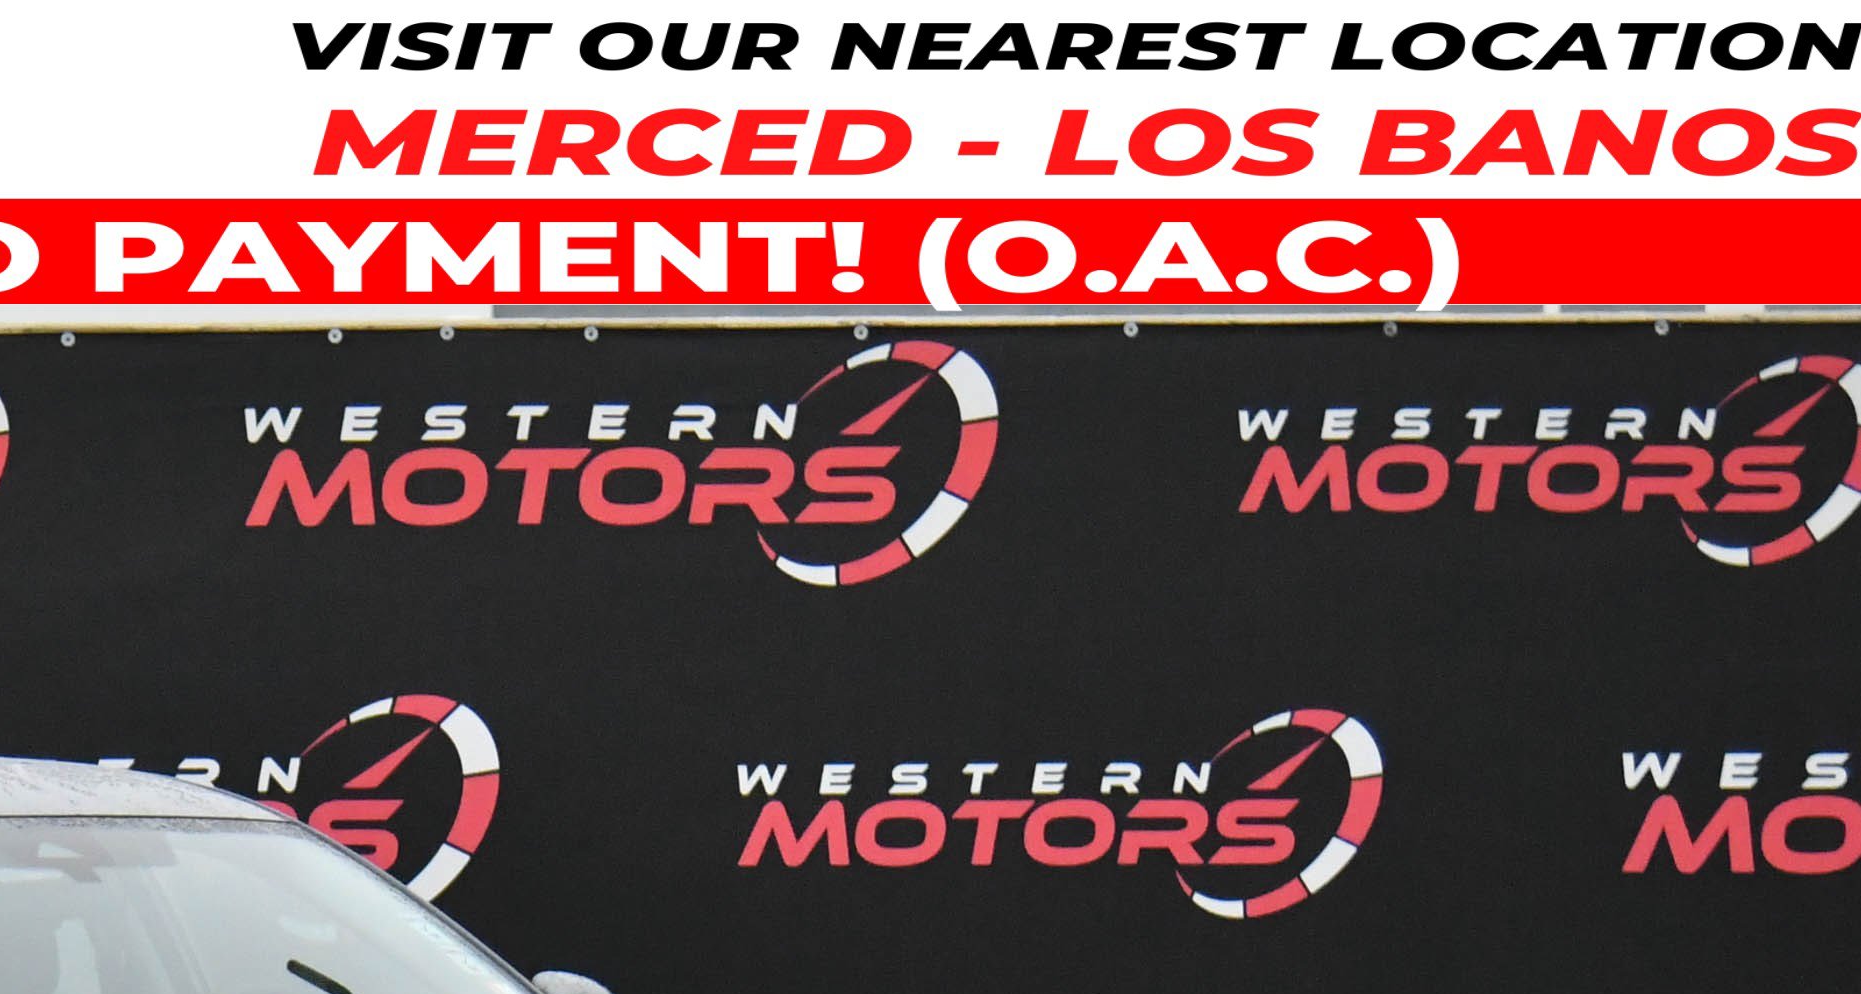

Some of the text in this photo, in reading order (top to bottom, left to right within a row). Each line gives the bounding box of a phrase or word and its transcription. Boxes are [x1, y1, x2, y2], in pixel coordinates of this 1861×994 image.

[244, 403, 797, 443] WESTERN
[1238, 408, 1717, 441] WESTERN
[246, 446, 901, 527] MOTORS
[1240, 445, 1805, 513] MOTORS
[737, 762, 1211, 795] WESTERN
[738, 798, 1299, 867] MOTORS
